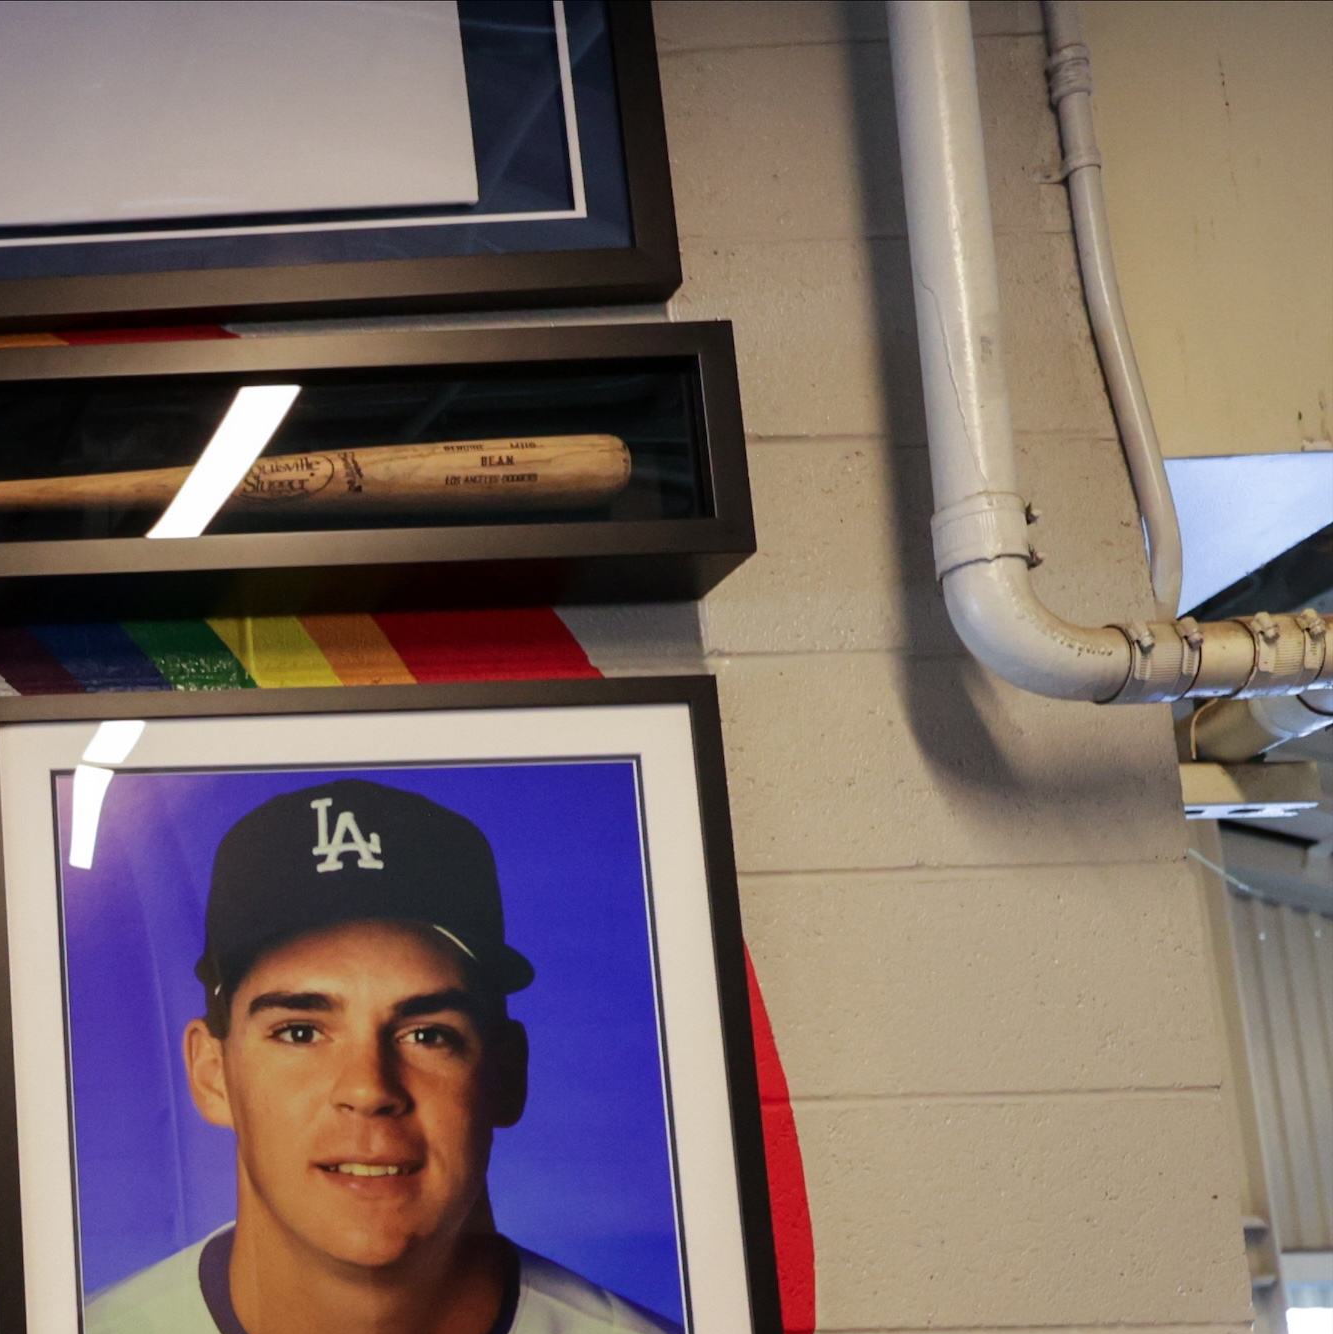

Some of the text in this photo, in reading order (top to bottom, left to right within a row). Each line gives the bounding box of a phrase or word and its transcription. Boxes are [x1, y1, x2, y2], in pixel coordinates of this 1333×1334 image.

[251, 457, 321, 476] ouisville
[481, 456, 515, 467] BEAN
[445, 475, 462, 486] LOS
[310, 797, 384, 873] LA
